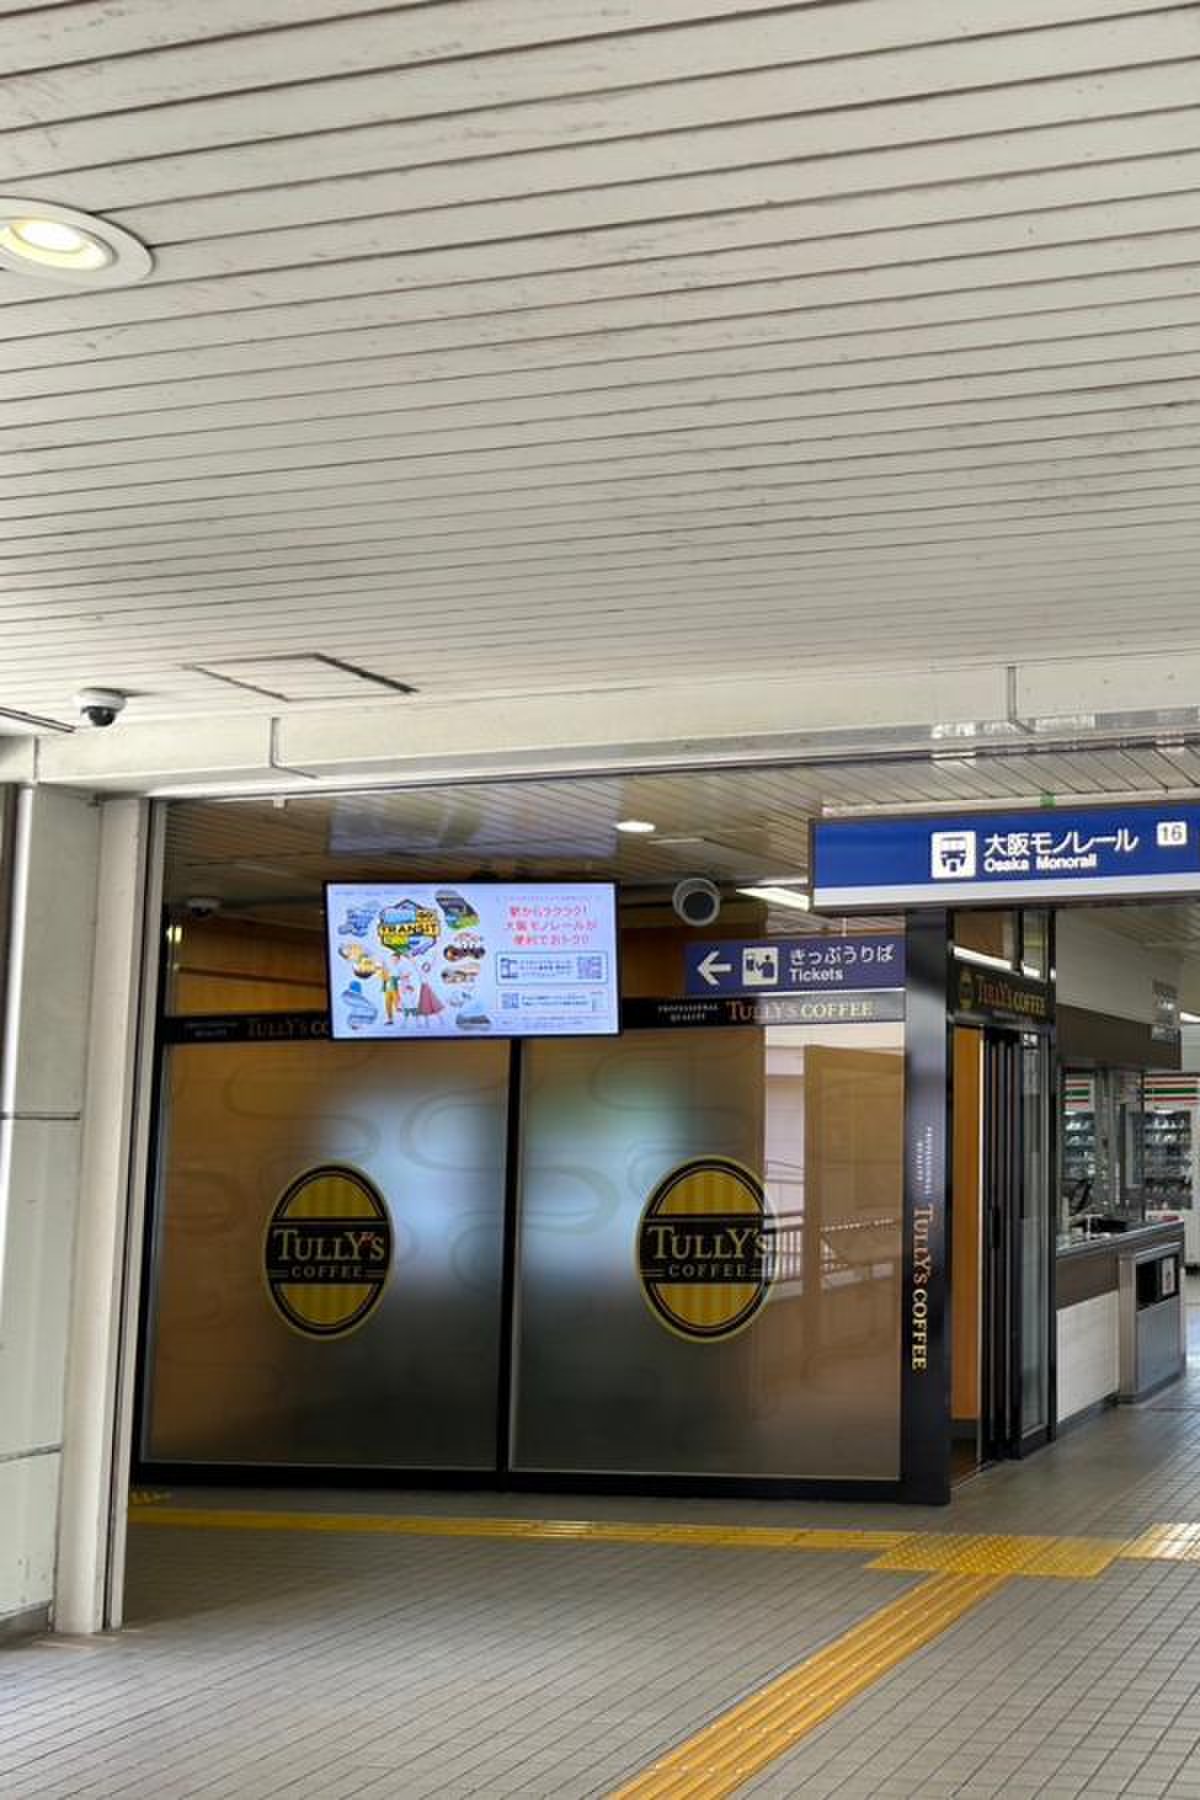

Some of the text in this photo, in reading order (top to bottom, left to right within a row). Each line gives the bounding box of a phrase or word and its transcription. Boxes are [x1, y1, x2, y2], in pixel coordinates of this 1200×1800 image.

[984, 829, 1139, 856] 大阪モノレール
[1161, 825, 1183, 842] 16
[984, 854, 1097, 872] Osaka Monorail
[789, 943, 895, 966] きっぷうりば
[789, 967, 843, 982] Tickets
[800, 1001, 874, 1018] COFFEE
[273, 1228, 385, 1261] TULLY'S
[646, 1225, 769, 1260] TULLY'S
[291, 1265, 364, 1279] COFFEE
[668, 1263, 747, 1278] COFFEE
[911, 1203, 935, 1371] TULLY'S COFFEE
